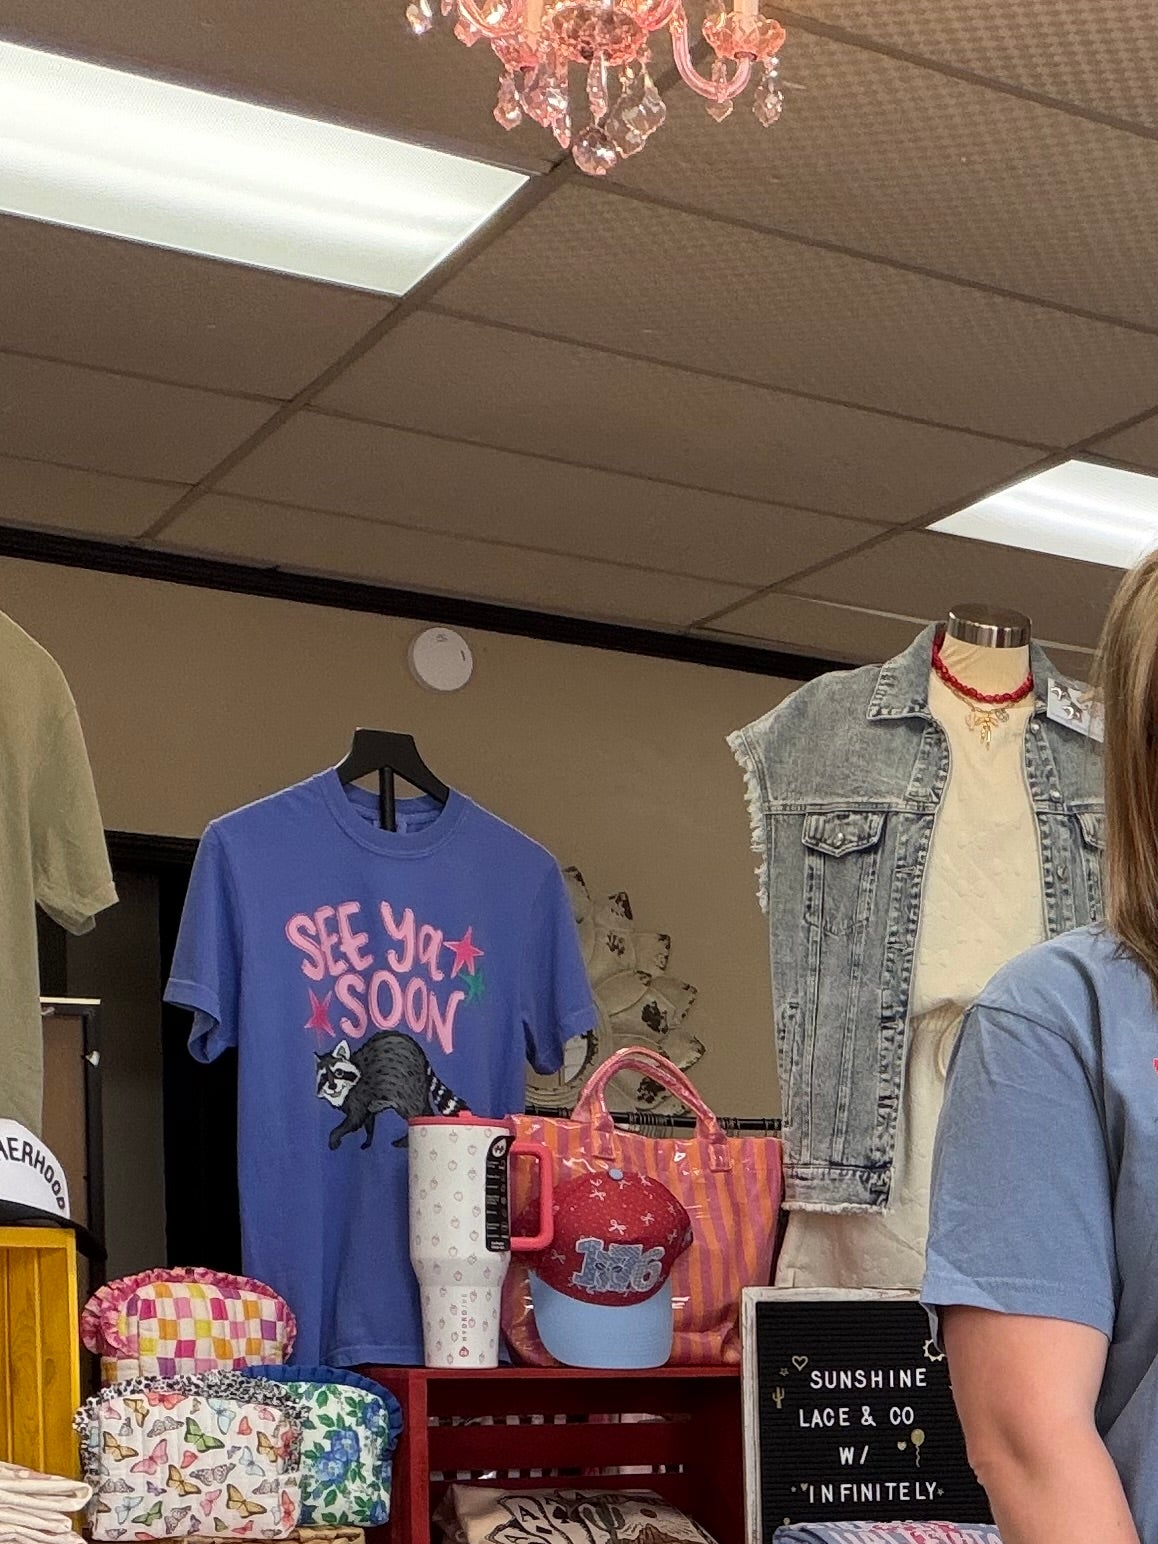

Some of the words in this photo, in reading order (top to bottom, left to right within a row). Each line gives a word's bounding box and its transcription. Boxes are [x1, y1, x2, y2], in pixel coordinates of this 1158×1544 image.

[285, 901, 374, 981] SEE
[335, 970, 465, 1055] SOON
[809, 1368, 928, 1389] SUNSHINE
[799, 1408, 850, 1428] LACE
[860, 1405, 877, 1426] &
[889, 1407, 915, 1425] CO
[809, 1482, 937, 1504] INFINITELY
